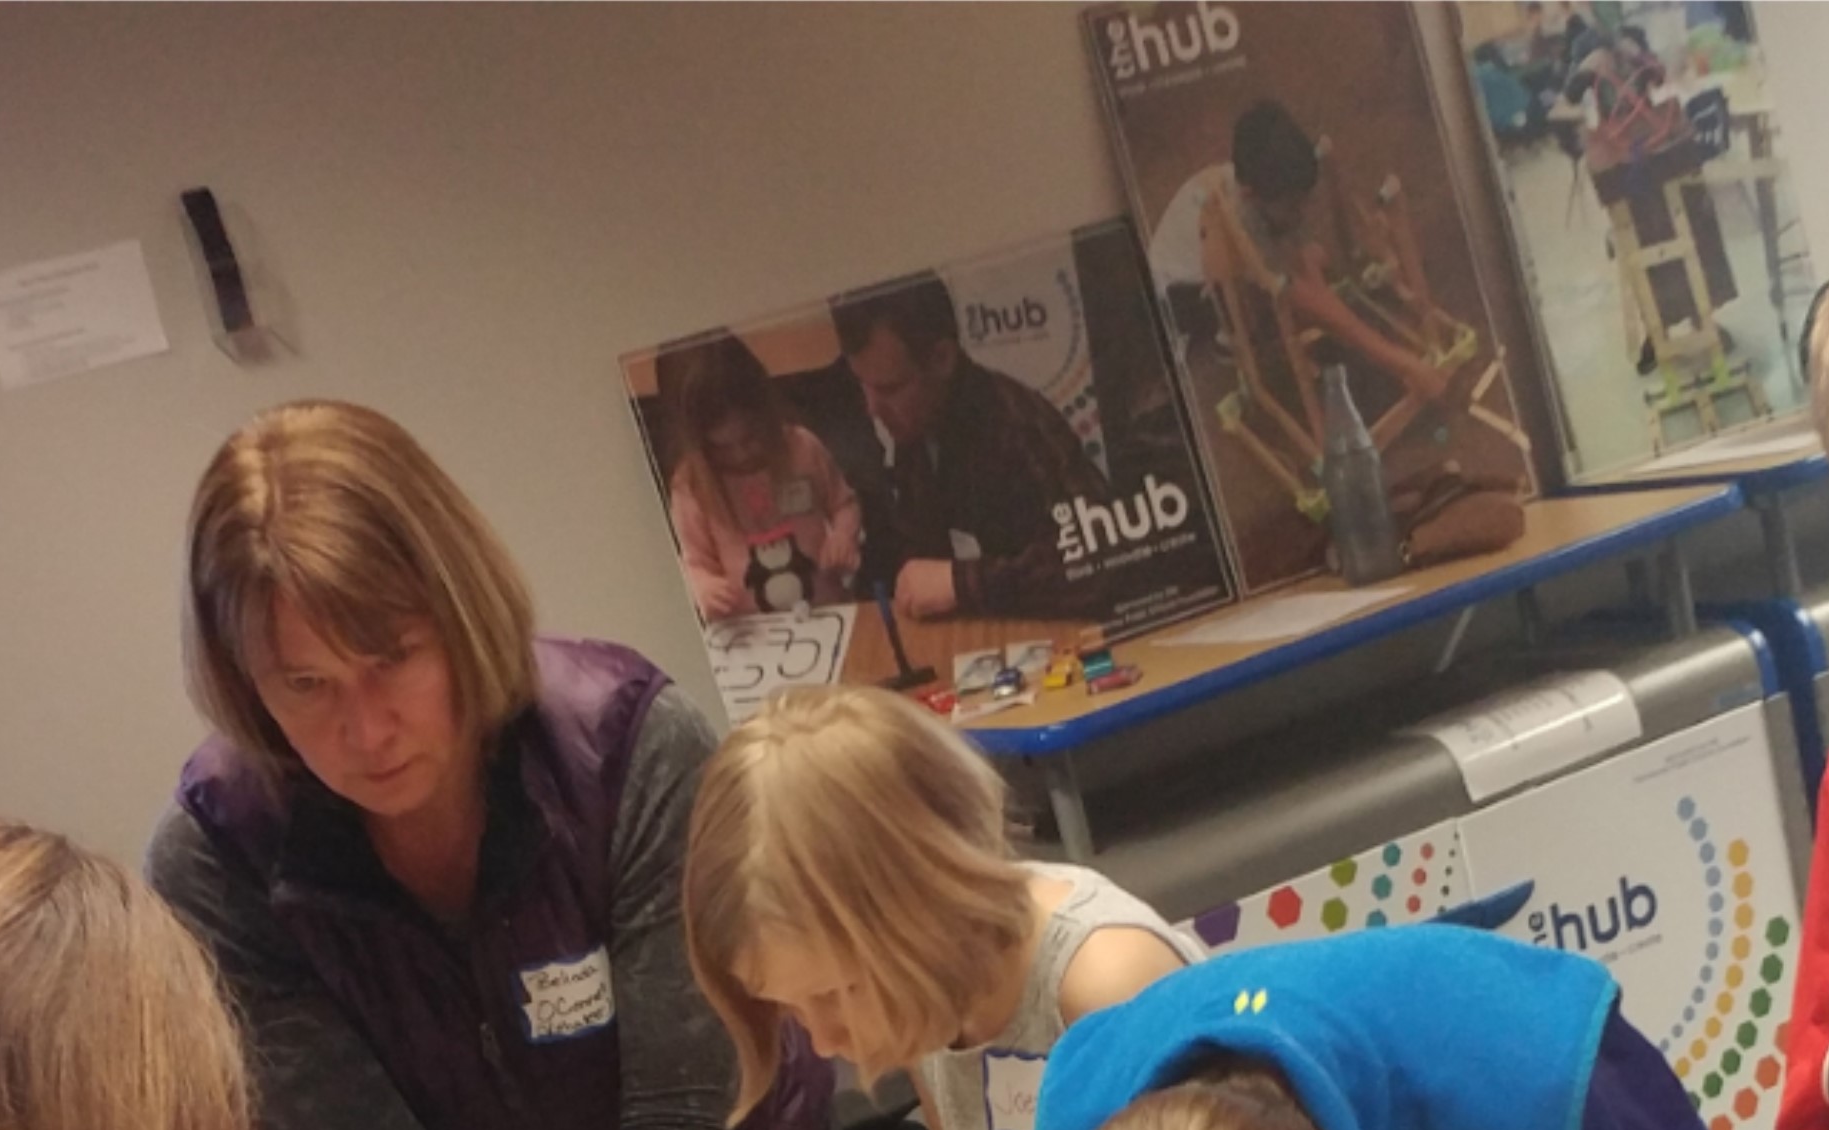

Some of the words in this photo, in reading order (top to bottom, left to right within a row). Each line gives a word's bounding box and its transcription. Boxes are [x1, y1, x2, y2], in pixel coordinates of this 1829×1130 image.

[1128, 0, 1239, 71] hub
[980, 297, 1047, 334] hub
[1052, 503, 1084, 563] the
[1074, 474, 1188, 553] hub
[1549, 875, 1657, 951] hub
